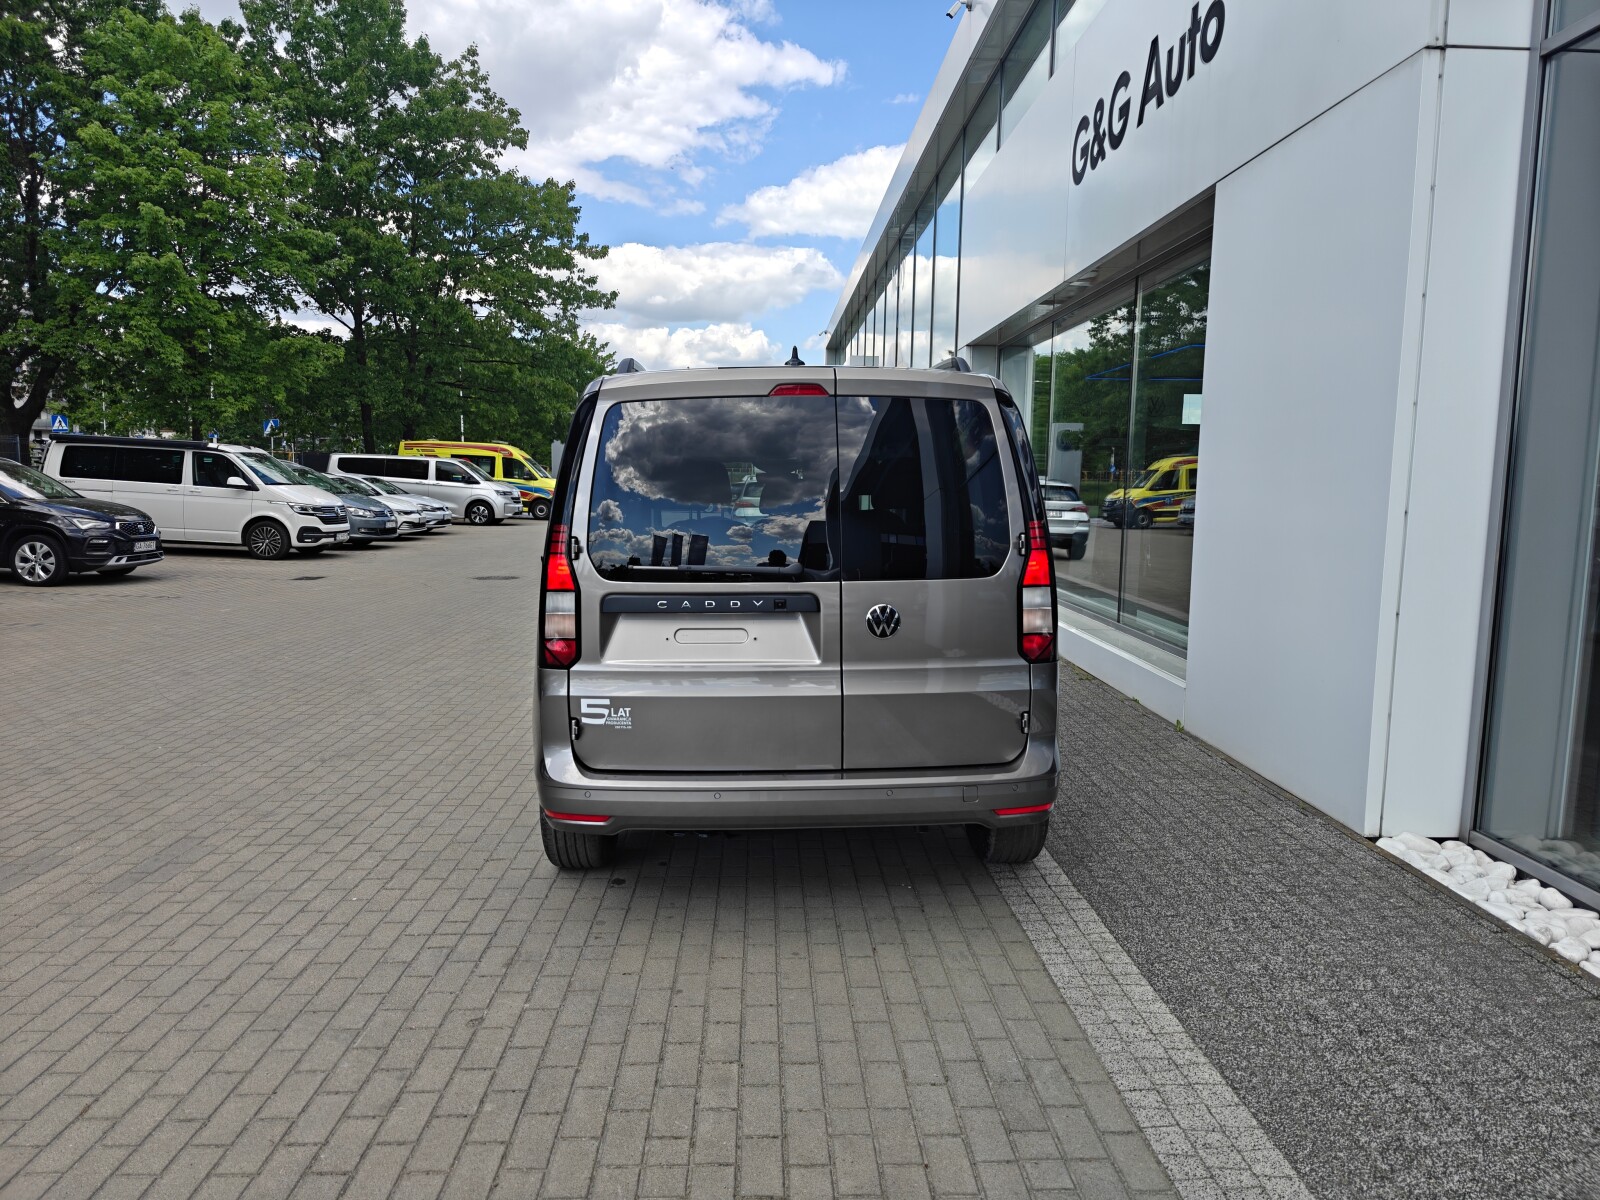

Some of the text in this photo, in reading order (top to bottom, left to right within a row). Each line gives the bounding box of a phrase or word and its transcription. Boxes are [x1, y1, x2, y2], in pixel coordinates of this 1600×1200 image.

[1072, 0, 1225, 186] G&G Auto
[656, 600, 764, 609] CADDY
[580, 698, 632, 725] 5 LAT
